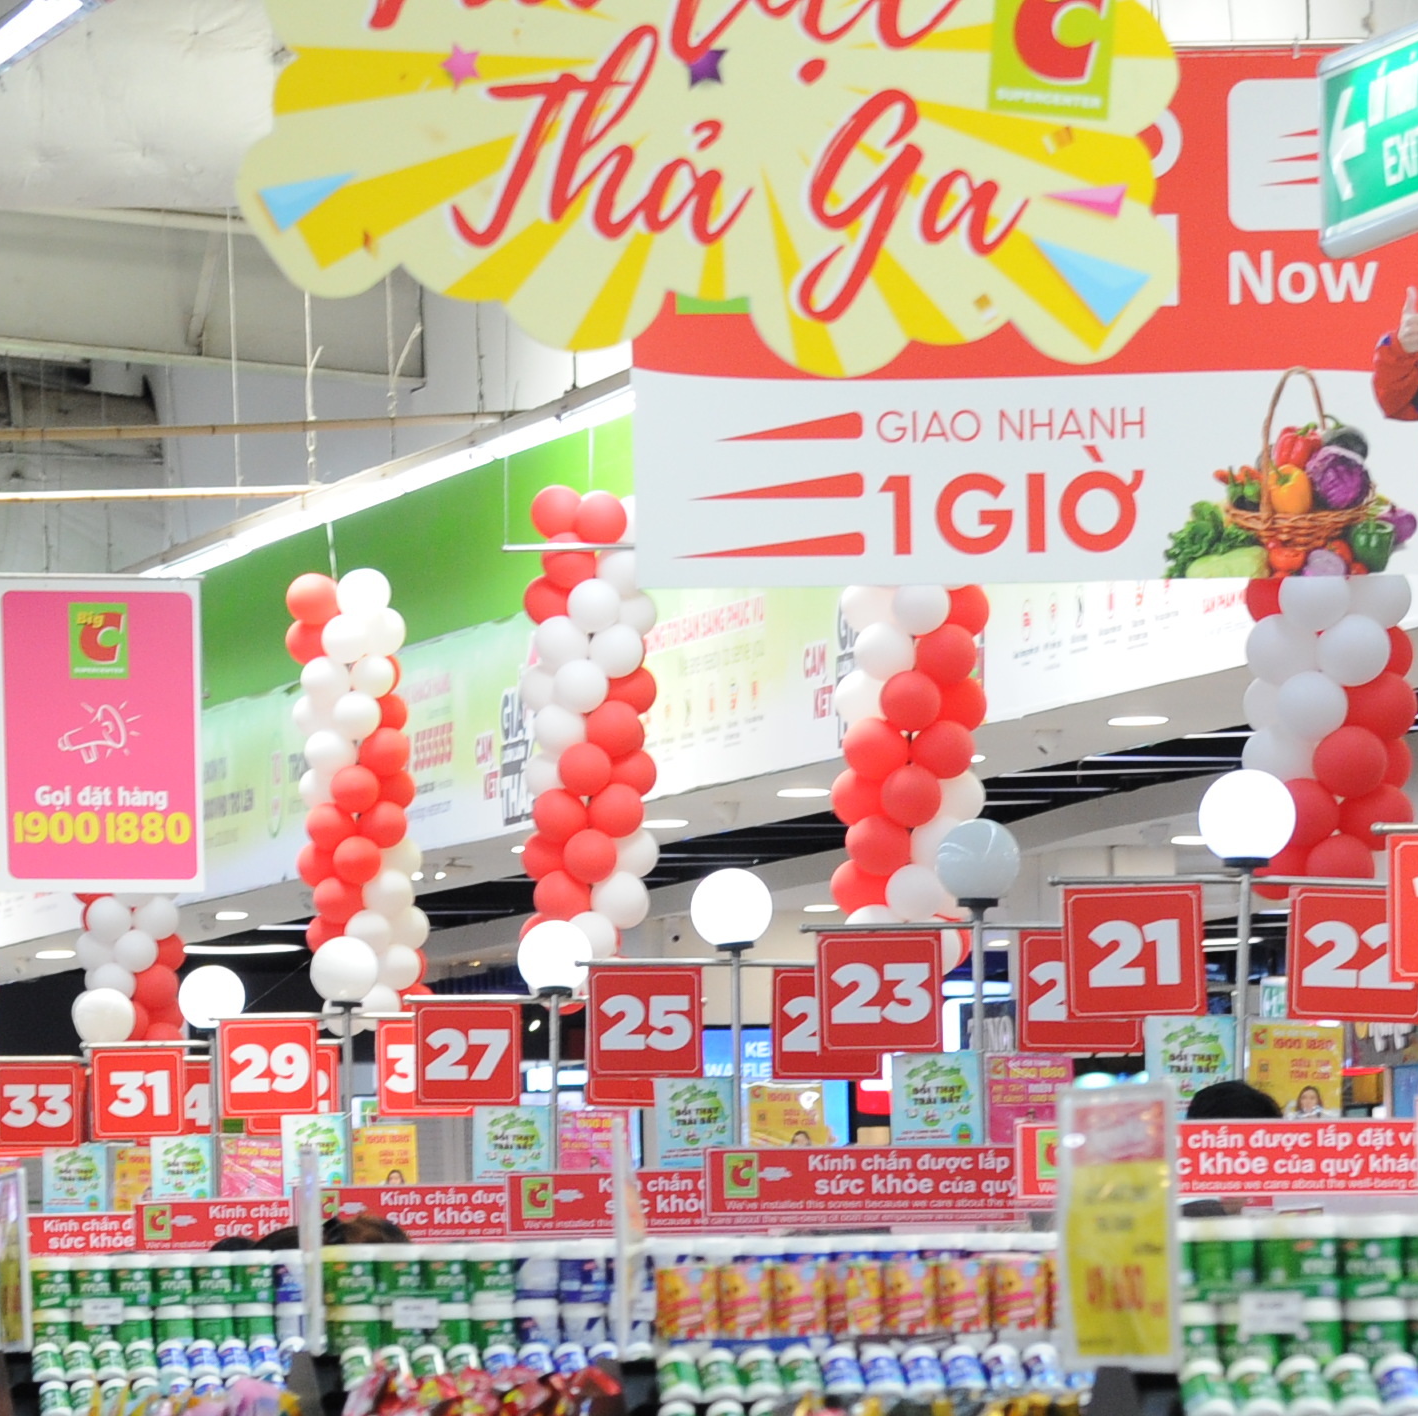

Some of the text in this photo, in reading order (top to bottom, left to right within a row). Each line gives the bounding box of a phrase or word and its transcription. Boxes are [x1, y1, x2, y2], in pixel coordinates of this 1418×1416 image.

[995, 87, 1102, 109] SUPERCENTER
[452, 23, 1032, 322] Thả Ga
[1228, 250, 1378, 305] Now
[877, 407, 1145, 444] GIAO NHANH
[76, 612, 106, 628] Big
[79, 611, 124, 664] C
[803, 643, 827, 679] CAM
[35, 785, 168, 811] Gọi đặt hàng
[13, 811, 192, 844] 1900 1880
[1088, 919, 1181, 988] 21
[830, 962, 932, 1024] 23
[599, 994, 693, 1051] 25
[230, 1042, 310, 1093] 29
[425, 1028, 511, 1081] 27
[1, 1083, 73, 1129] 33
[108, 1070, 172, 1118] 31
